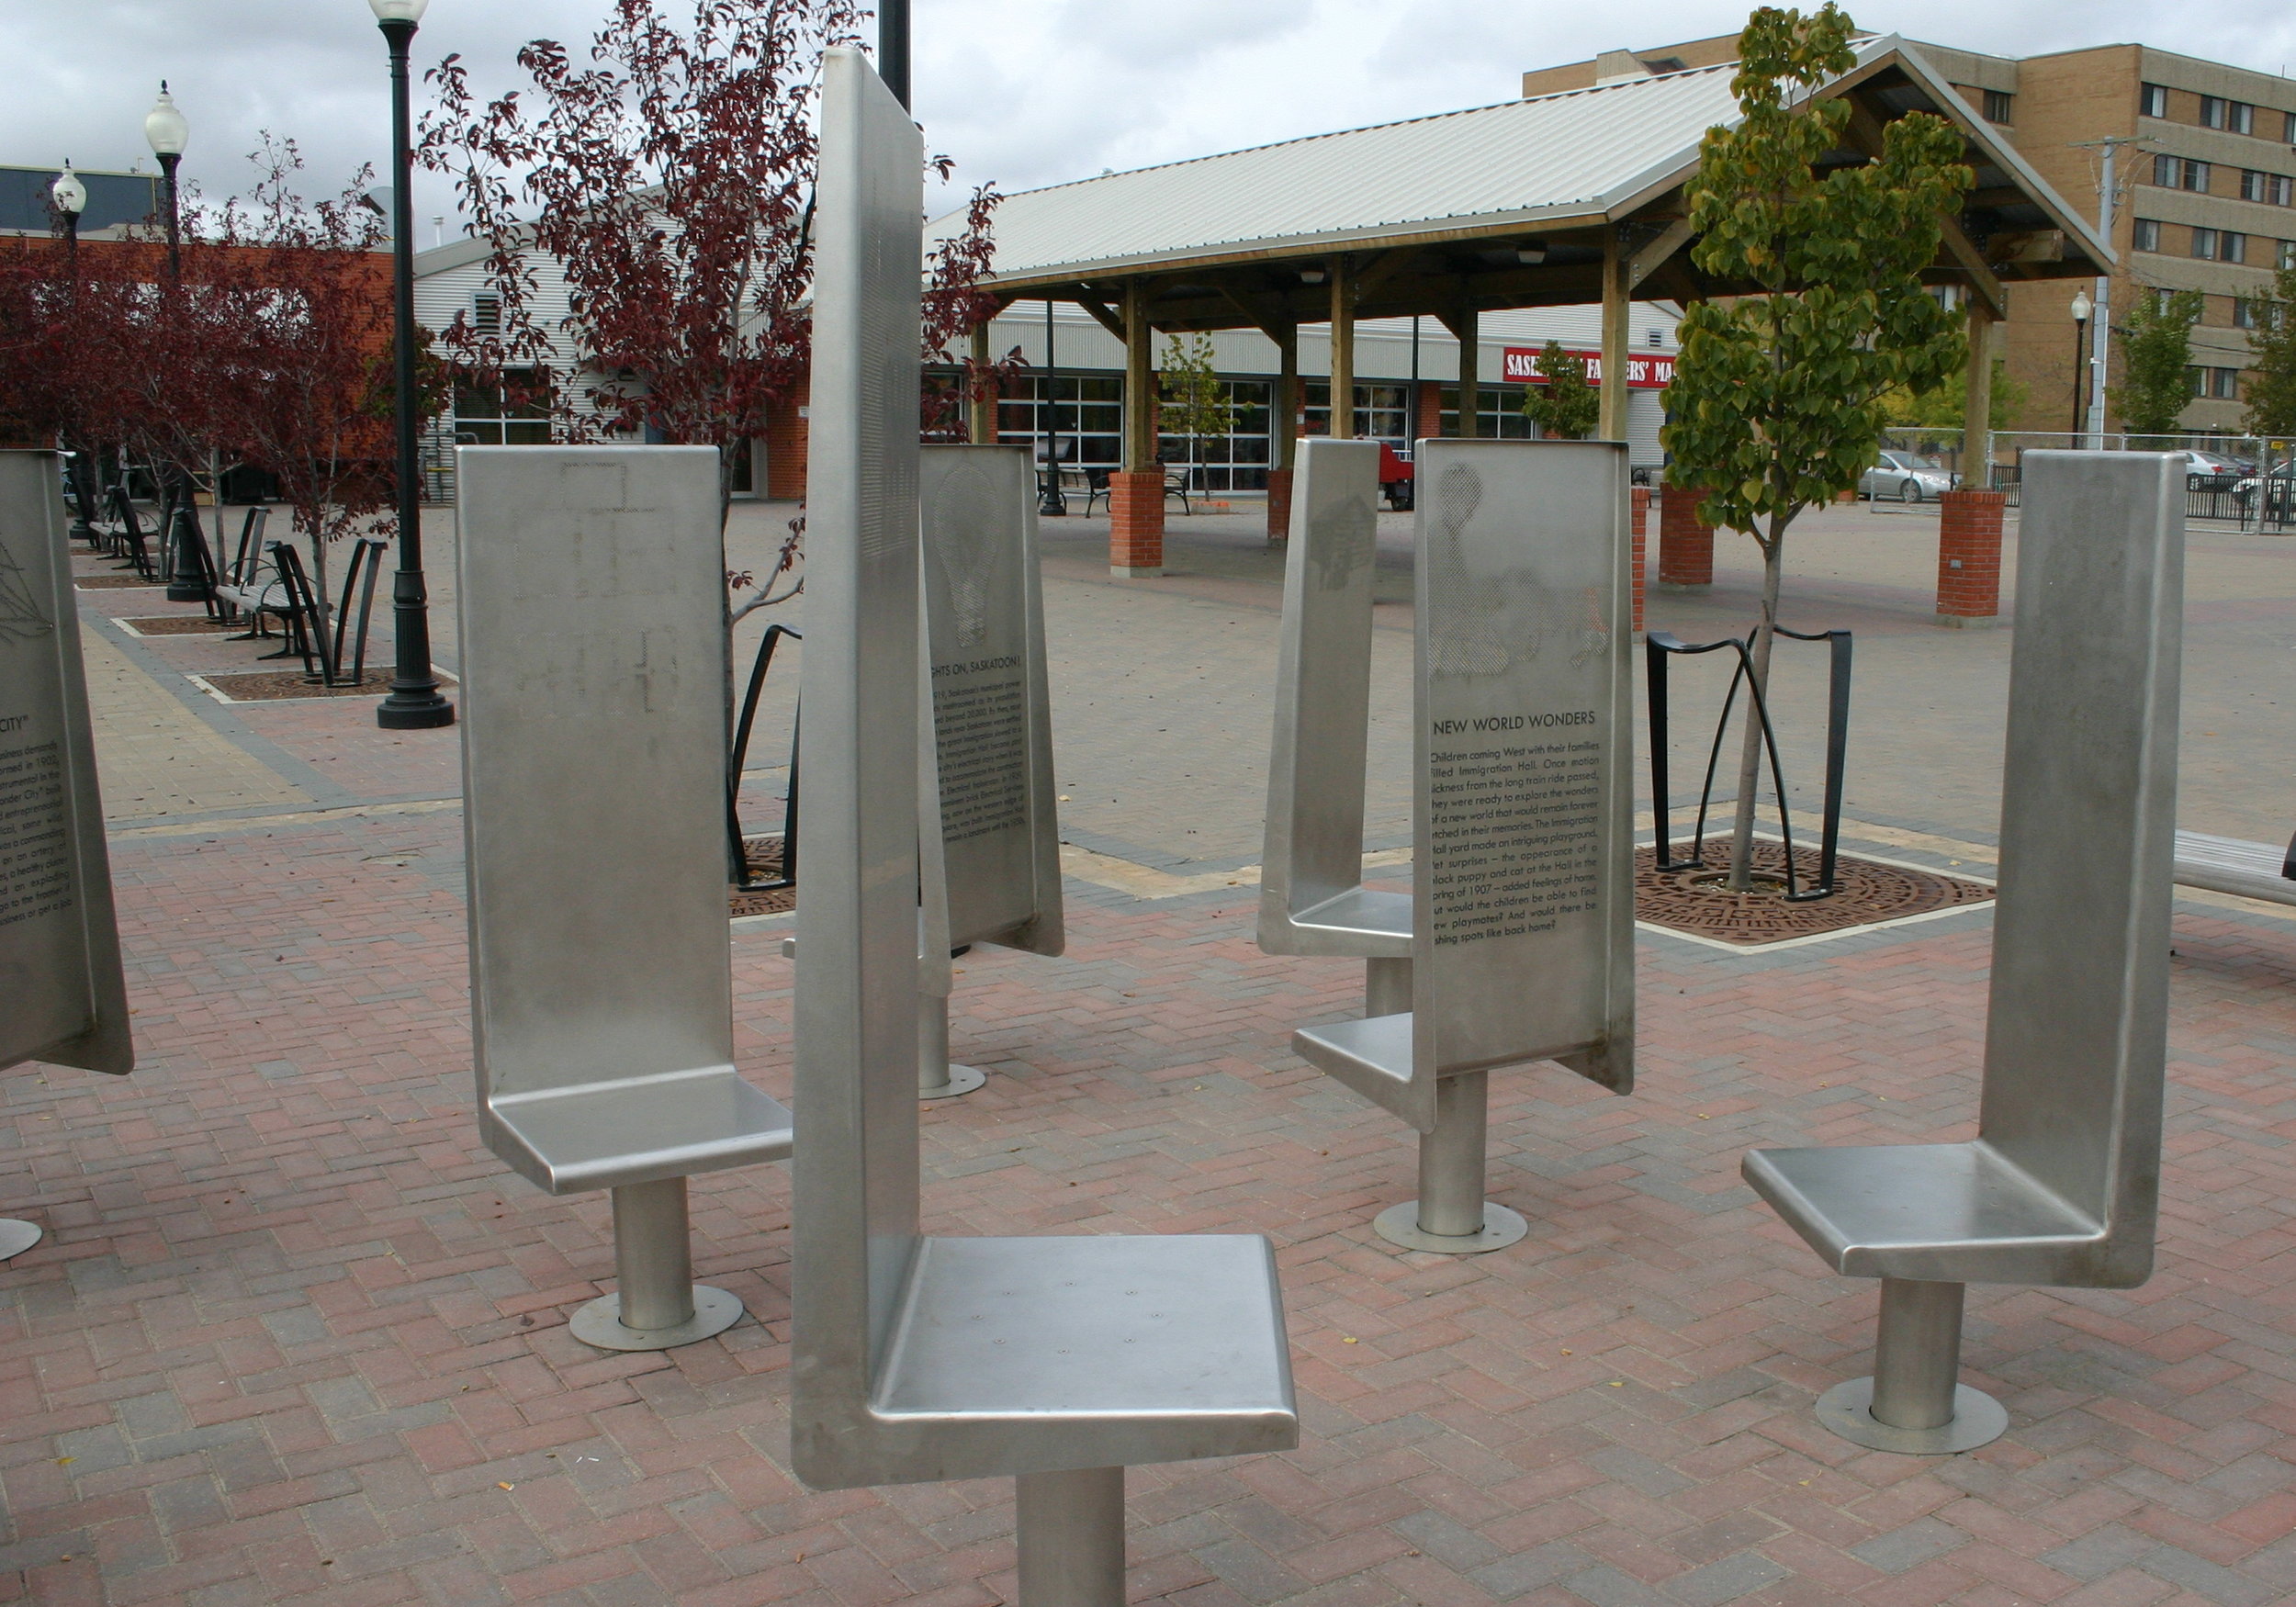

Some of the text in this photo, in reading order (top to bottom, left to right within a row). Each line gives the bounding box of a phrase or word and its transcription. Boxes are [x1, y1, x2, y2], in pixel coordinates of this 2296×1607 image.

[1586, 358, 1649, 381] FARS'
[931, 656, 1020, 678] GHTS ON, SASKATOON!
[1434, 711, 1595, 736] NEW WORLD WONDERS
[1431, 741, 1600, 763] Children coming West with their families
[1459, 764, 1513, 777] Immigration
[1544, 759, 1566, 770] Once
[1571, 757, 1600, 767] motion
[1431, 771, 1600, 794] ickness from the long train ride passed,
[0, 794, 22, 805] onder
[1431, 786, 1599, 810] hey were ready to explore the wonders
[1449, 815, 1467, 823] new
[1469, 810, 1494, 821] world
[1496, 808, 1512, 818] that
[1514, 805, 1538, 816] would
[1540, 804, 1568, 814] remain
[1570, 801, 1598, 812] forever
[1461, 826, 1469, 837] in
[1471, 826, 1490, 836] their
[1536, 819, 1550, 829] The
[1551, 815, 1598, 827] Immigration
[1432, 860, 1443, 870] et
[1448, 857, 1488, 870] surprises
[1502, 853, 1515, 862] the
[1520, 847, 1573, 861] appearance
[1578, 844, 1588, 854] of
[1448, 842, 1469, 855] yard
[1471, 838, 1496, 850] made
[1498, 840, 1510, 848] an
[1511, 836, 1548, 848] intriguing
[1433, 857, 1597, 885] lack puppy and cat at the Hall in the
[1433, 890, 1455, 903] pring
[1457, 887, 1467, 897] of
[1469, 884, 1492, 896] 1907
[1502, 882, 1530, 893] added
[1532, 878, 1562, 890] feelings
[1564, 875, 1572, 884] of
[1434, 886, 1597, 916] ut would the children be able to find
[1434, 901, 1597, 930] ew playmates? And would there be
[1434, 920, 1556, 946] shing spots like back home?
